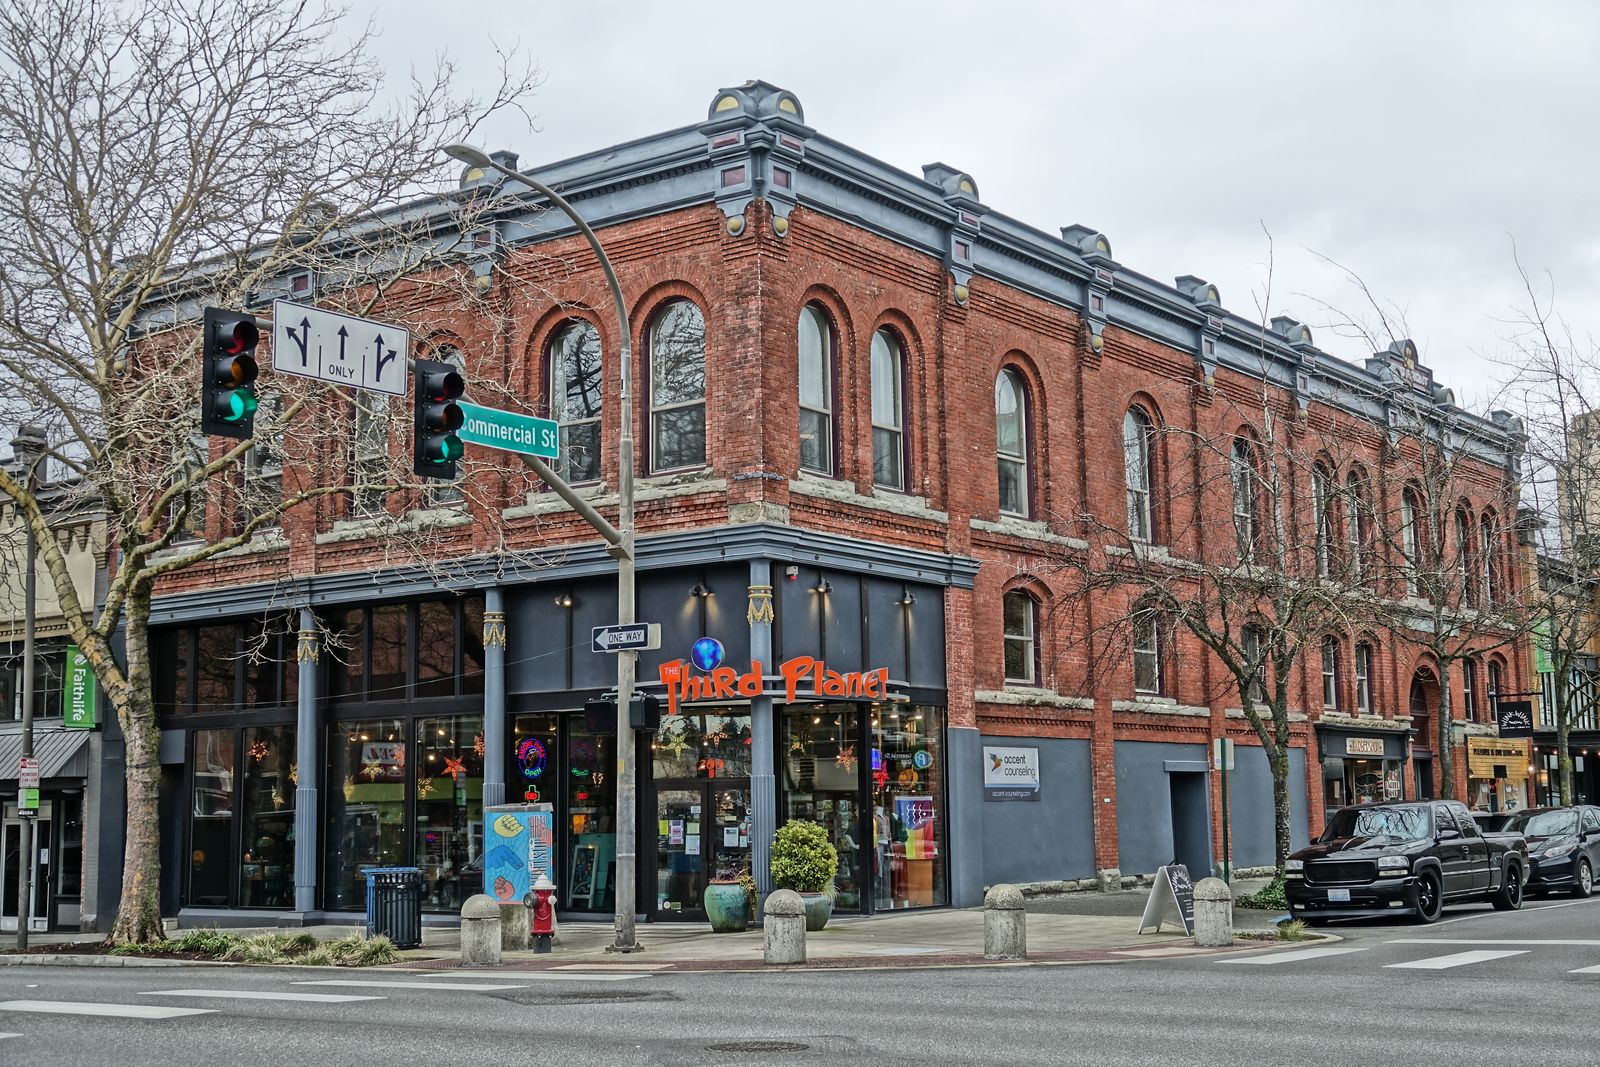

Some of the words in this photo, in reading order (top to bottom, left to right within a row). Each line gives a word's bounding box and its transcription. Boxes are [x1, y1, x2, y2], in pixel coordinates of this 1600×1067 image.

[328, 364, 355, 379] ONLY
[461, 418, 536, 446] ommercial
[541, 428, 556, 449] St
[608, 632, 624, 643] ONE
[626, 631, 642, 641] WAY
[664, 666, 680, 676] THE
[72, 668, 87, 721] Faithlife
[1003, 754, 1026, 765] accent
[1004, 766, 1036, 779] counseling
